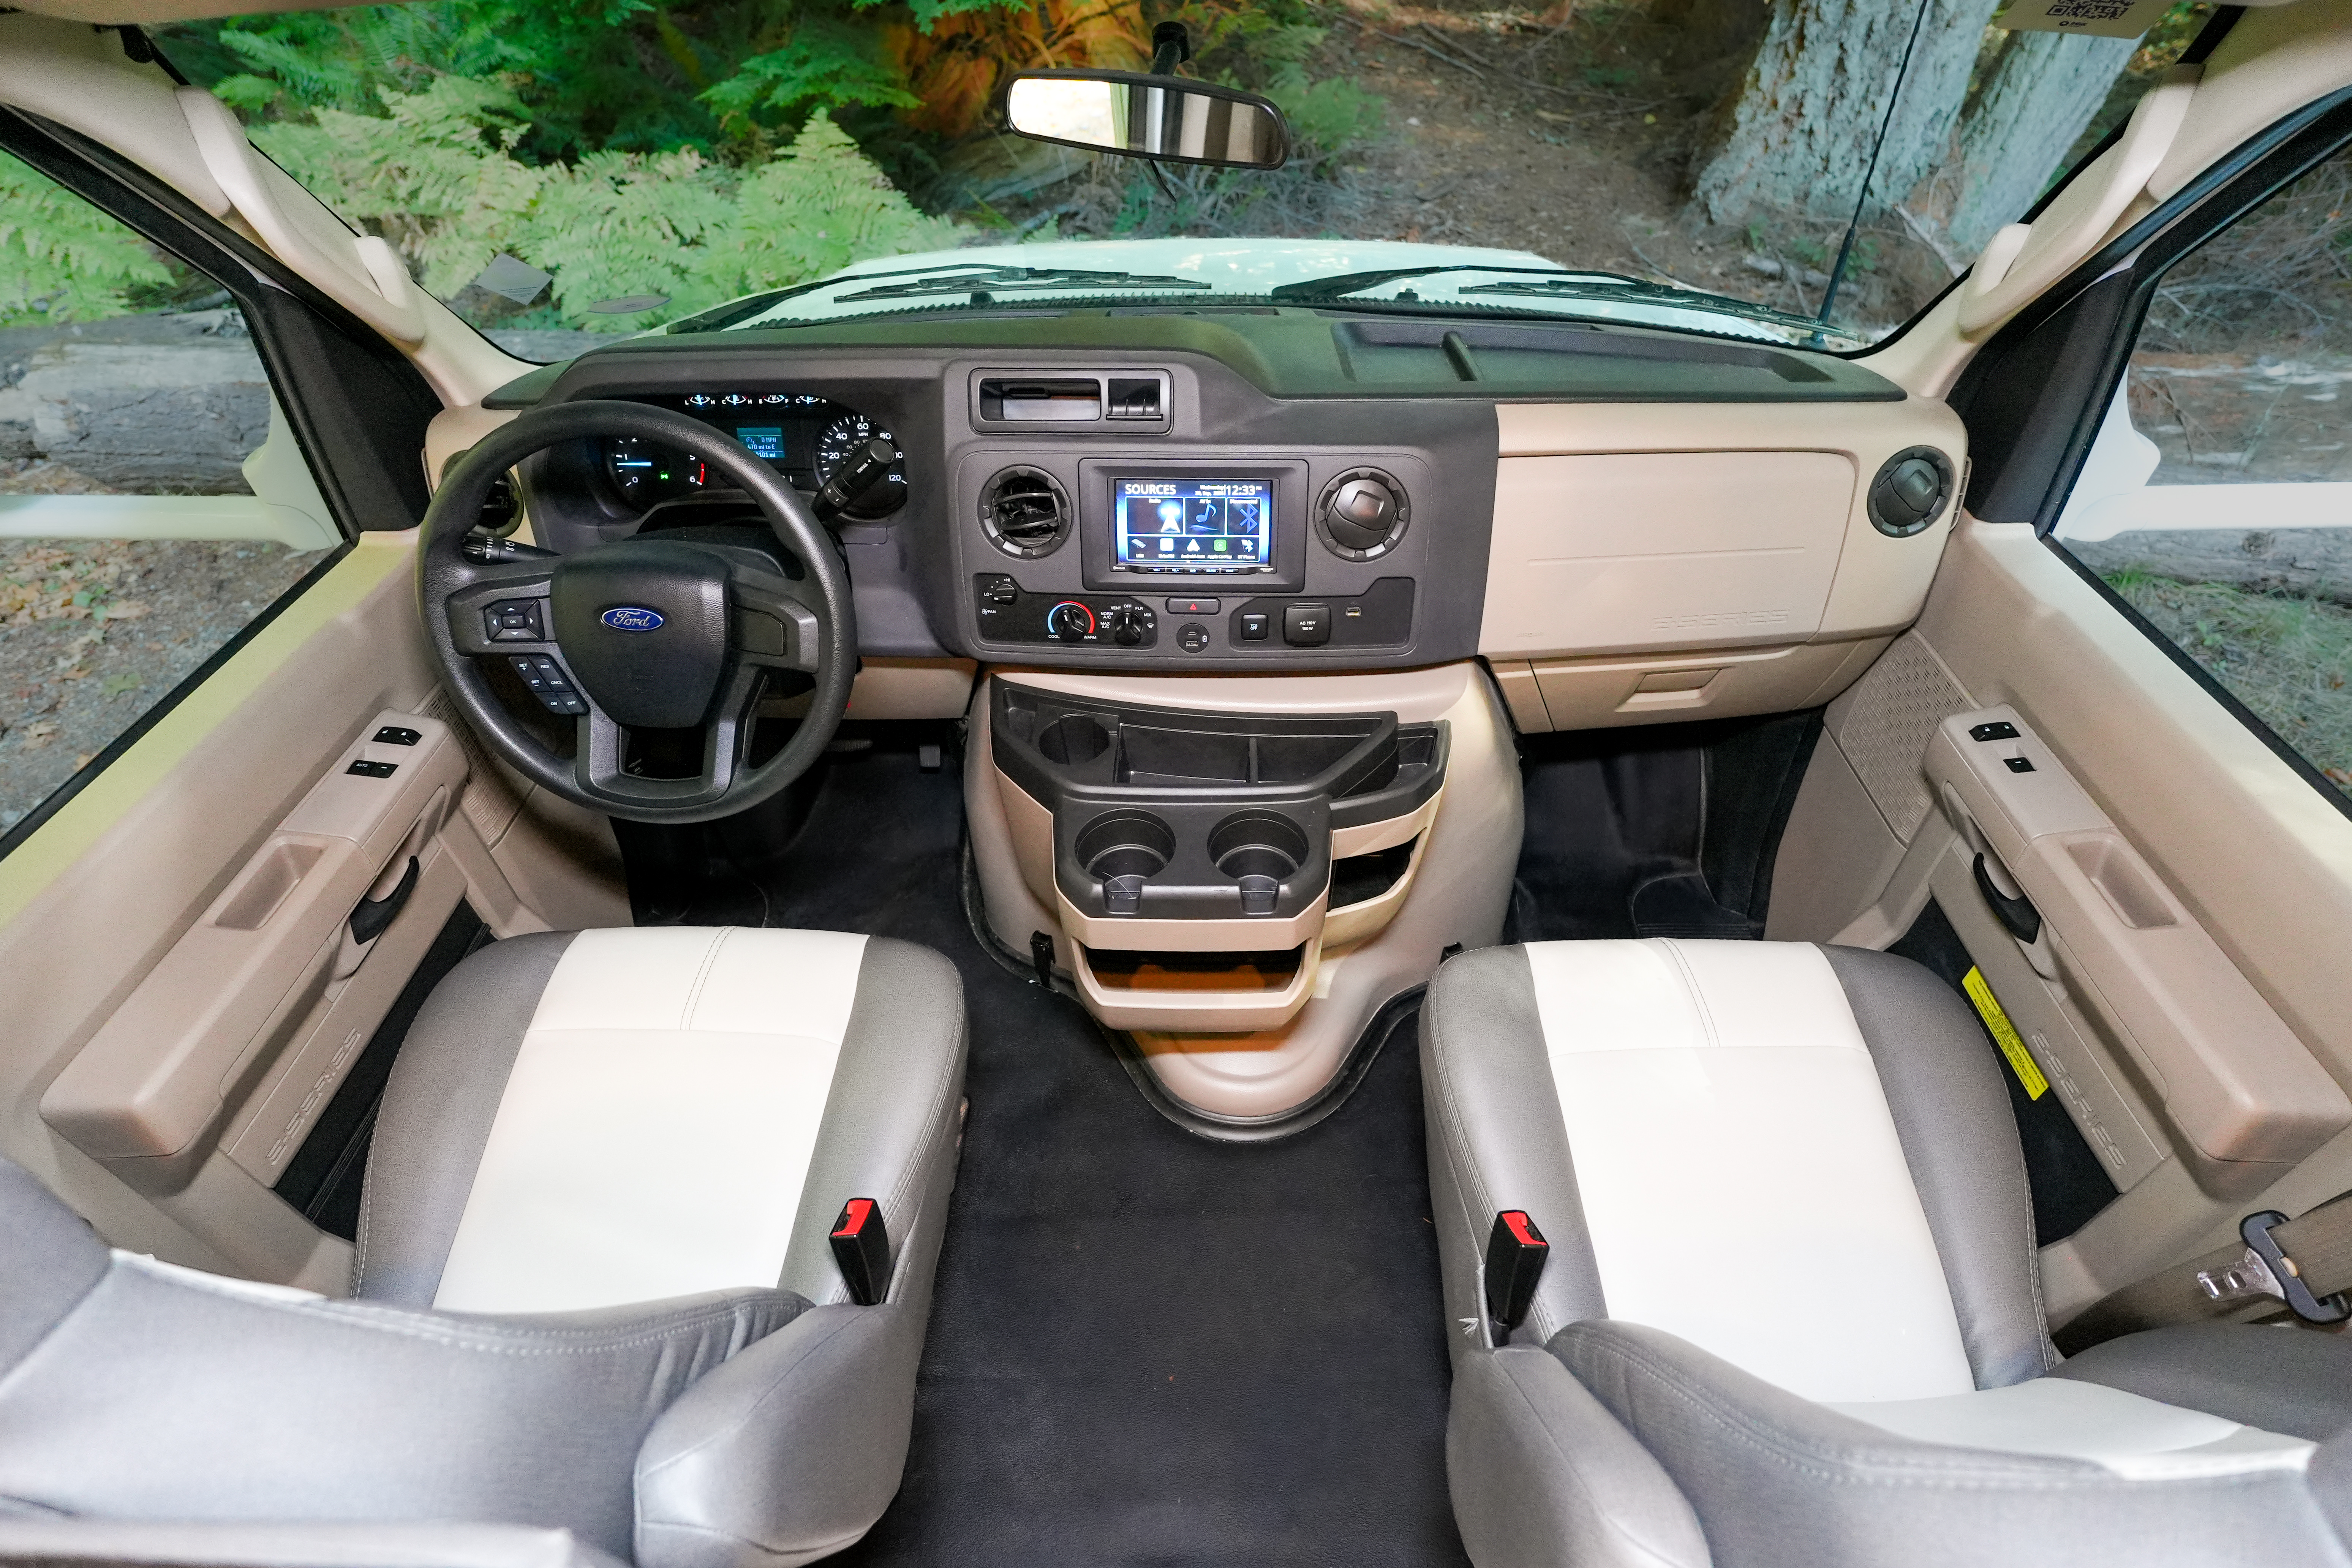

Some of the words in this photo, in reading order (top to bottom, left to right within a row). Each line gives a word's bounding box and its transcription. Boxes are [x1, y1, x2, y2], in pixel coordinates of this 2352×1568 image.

[1125, 484, 1176, 495] SOURCES
[1226, 485, 1256, 495] 12:33
[613, 610, 650, 627] Ford
[1652, 609, 1790, 629] E-SERIES
